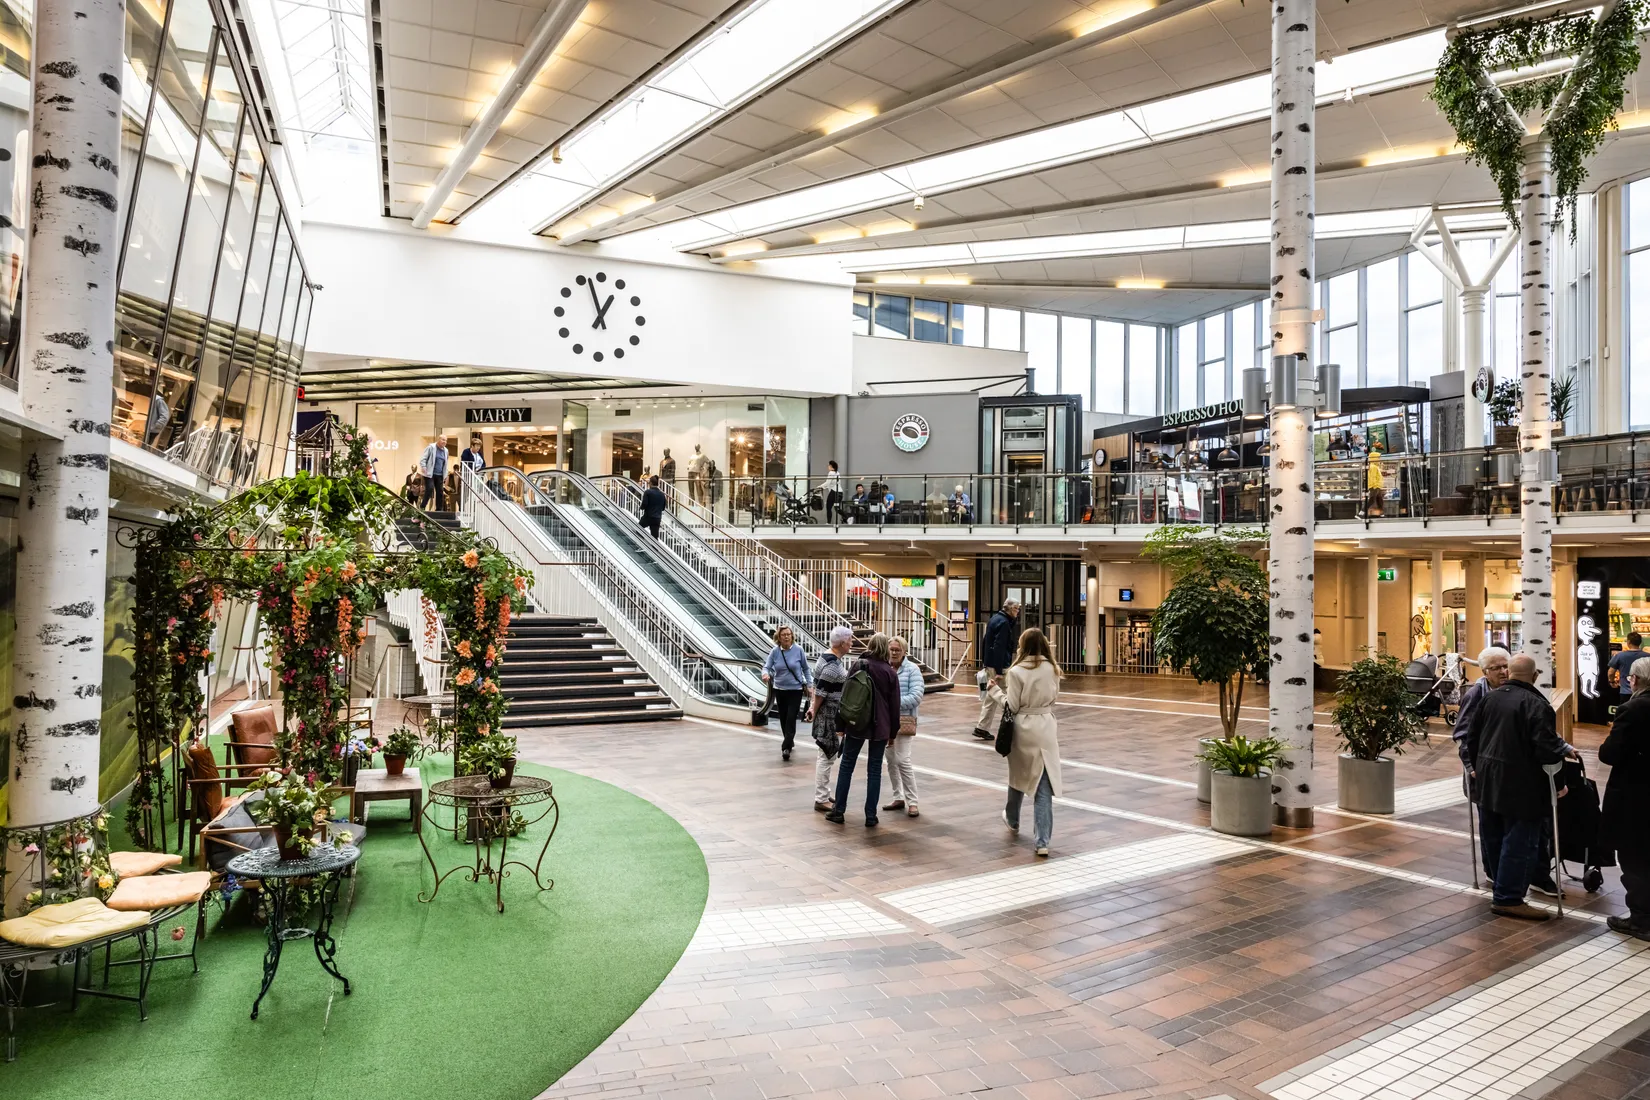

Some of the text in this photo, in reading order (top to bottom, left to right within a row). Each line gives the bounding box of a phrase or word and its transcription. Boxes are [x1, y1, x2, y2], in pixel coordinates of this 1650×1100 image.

[471, 408, 526, 422] MARTY
[1162, 399, 1245, 427] ESPRESSO HOU
[894, 415, 927, 431] ESPRESSO
[898, 439, 923, 449] HOUSE
